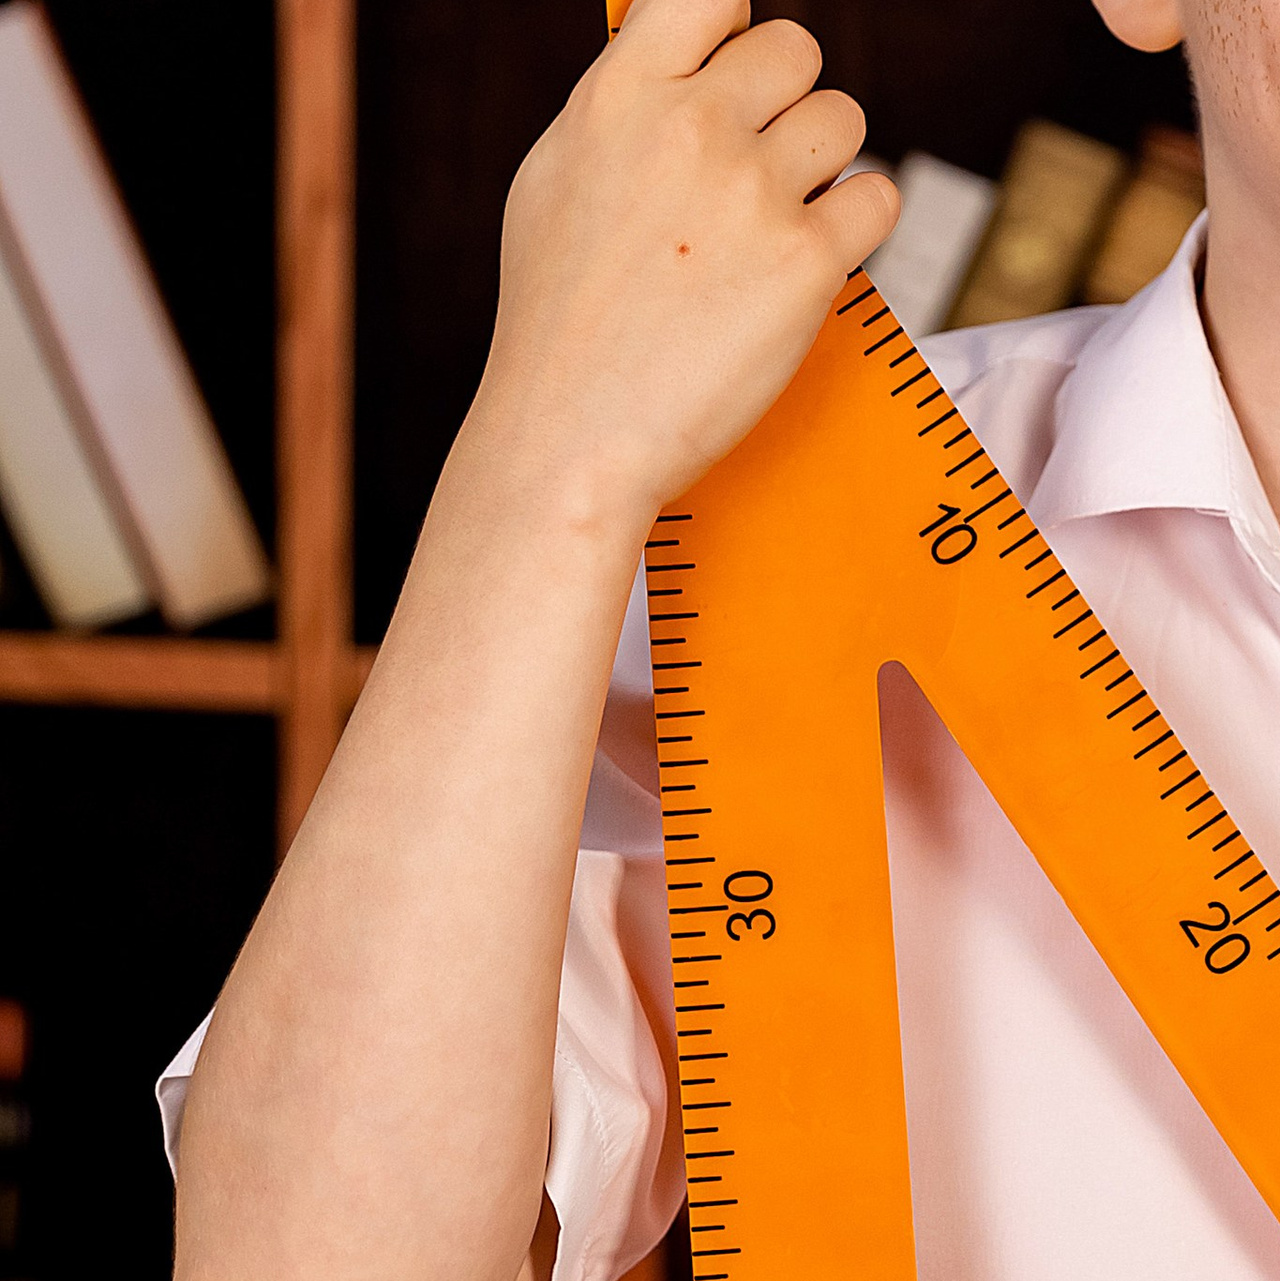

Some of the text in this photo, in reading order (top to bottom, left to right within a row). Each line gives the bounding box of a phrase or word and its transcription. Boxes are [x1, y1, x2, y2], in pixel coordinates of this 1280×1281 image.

[918, 503, 977, 565] 10
[723, 870, 777, 942] 30
[1178, 901, 1251, 975] 20
